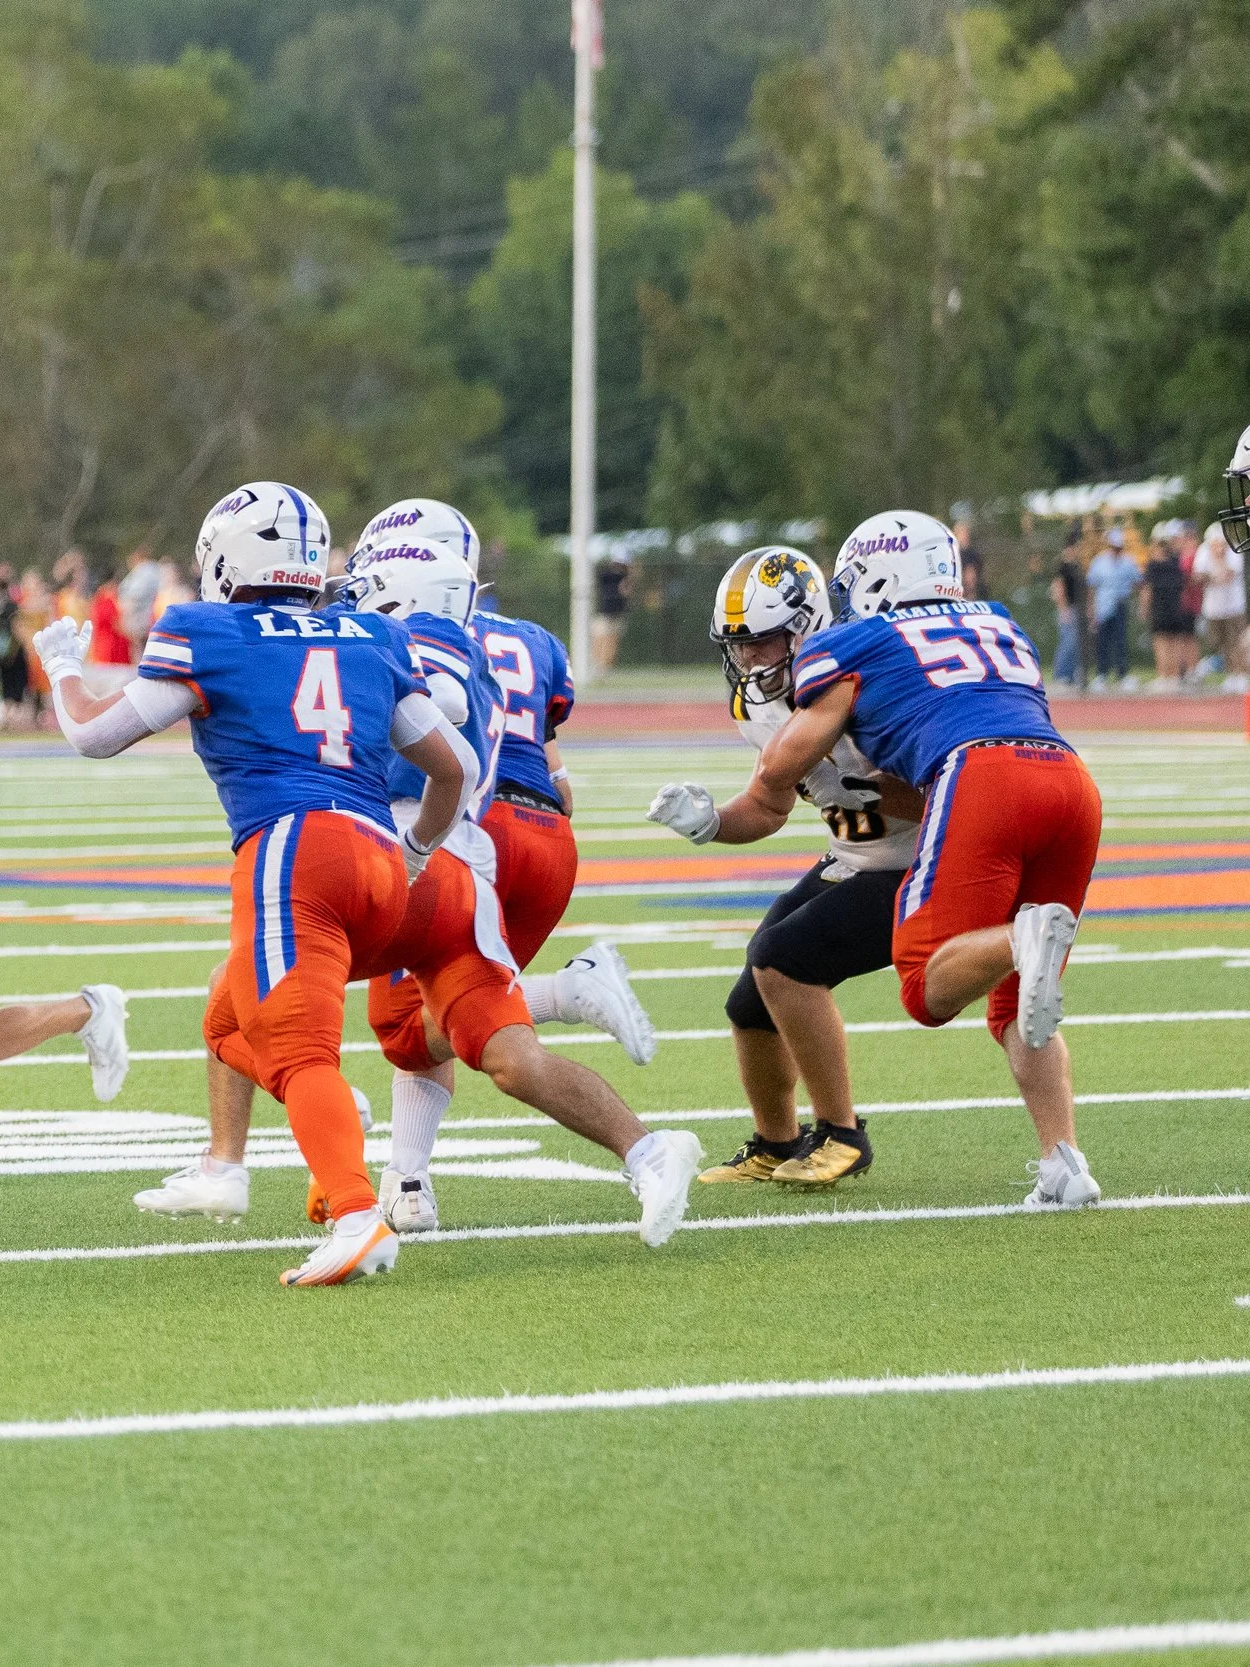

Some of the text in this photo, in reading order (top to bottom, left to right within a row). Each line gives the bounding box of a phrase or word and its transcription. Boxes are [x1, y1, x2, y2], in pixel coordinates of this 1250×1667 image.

[846, 533, 909, 562] Bruins
[272, 570, 322, 587] Riddell
[253, 613, 373, 638] LEA
[894, 614, 1040, 688] 50
[290, 647, 354, 767] 4
